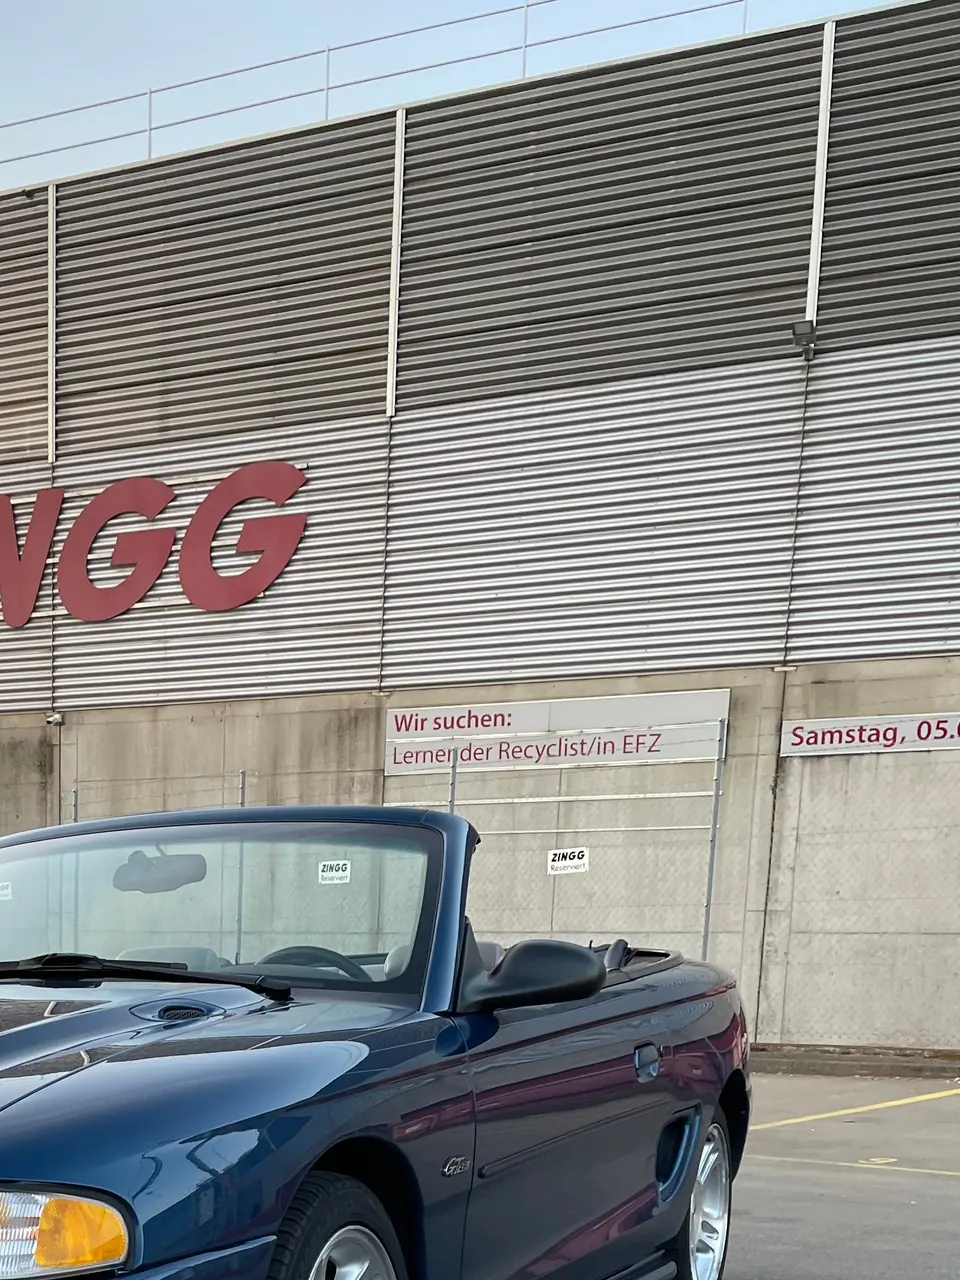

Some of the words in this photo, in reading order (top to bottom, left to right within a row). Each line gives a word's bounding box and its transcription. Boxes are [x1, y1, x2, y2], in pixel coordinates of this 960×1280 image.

[394, 712, 428, 732] Wir
[433, 709, 513, 731] suchen:
[791, 725, 907, 748] Samstag,
[917, 719, 960, 741] 05.
[498, 735, 616, 763] Recyclist/in
[622, 733, 662, 754] EFZ
[551, 850, 585, 862] ZINGG
[321, 863, 348, 873] ZINGG
